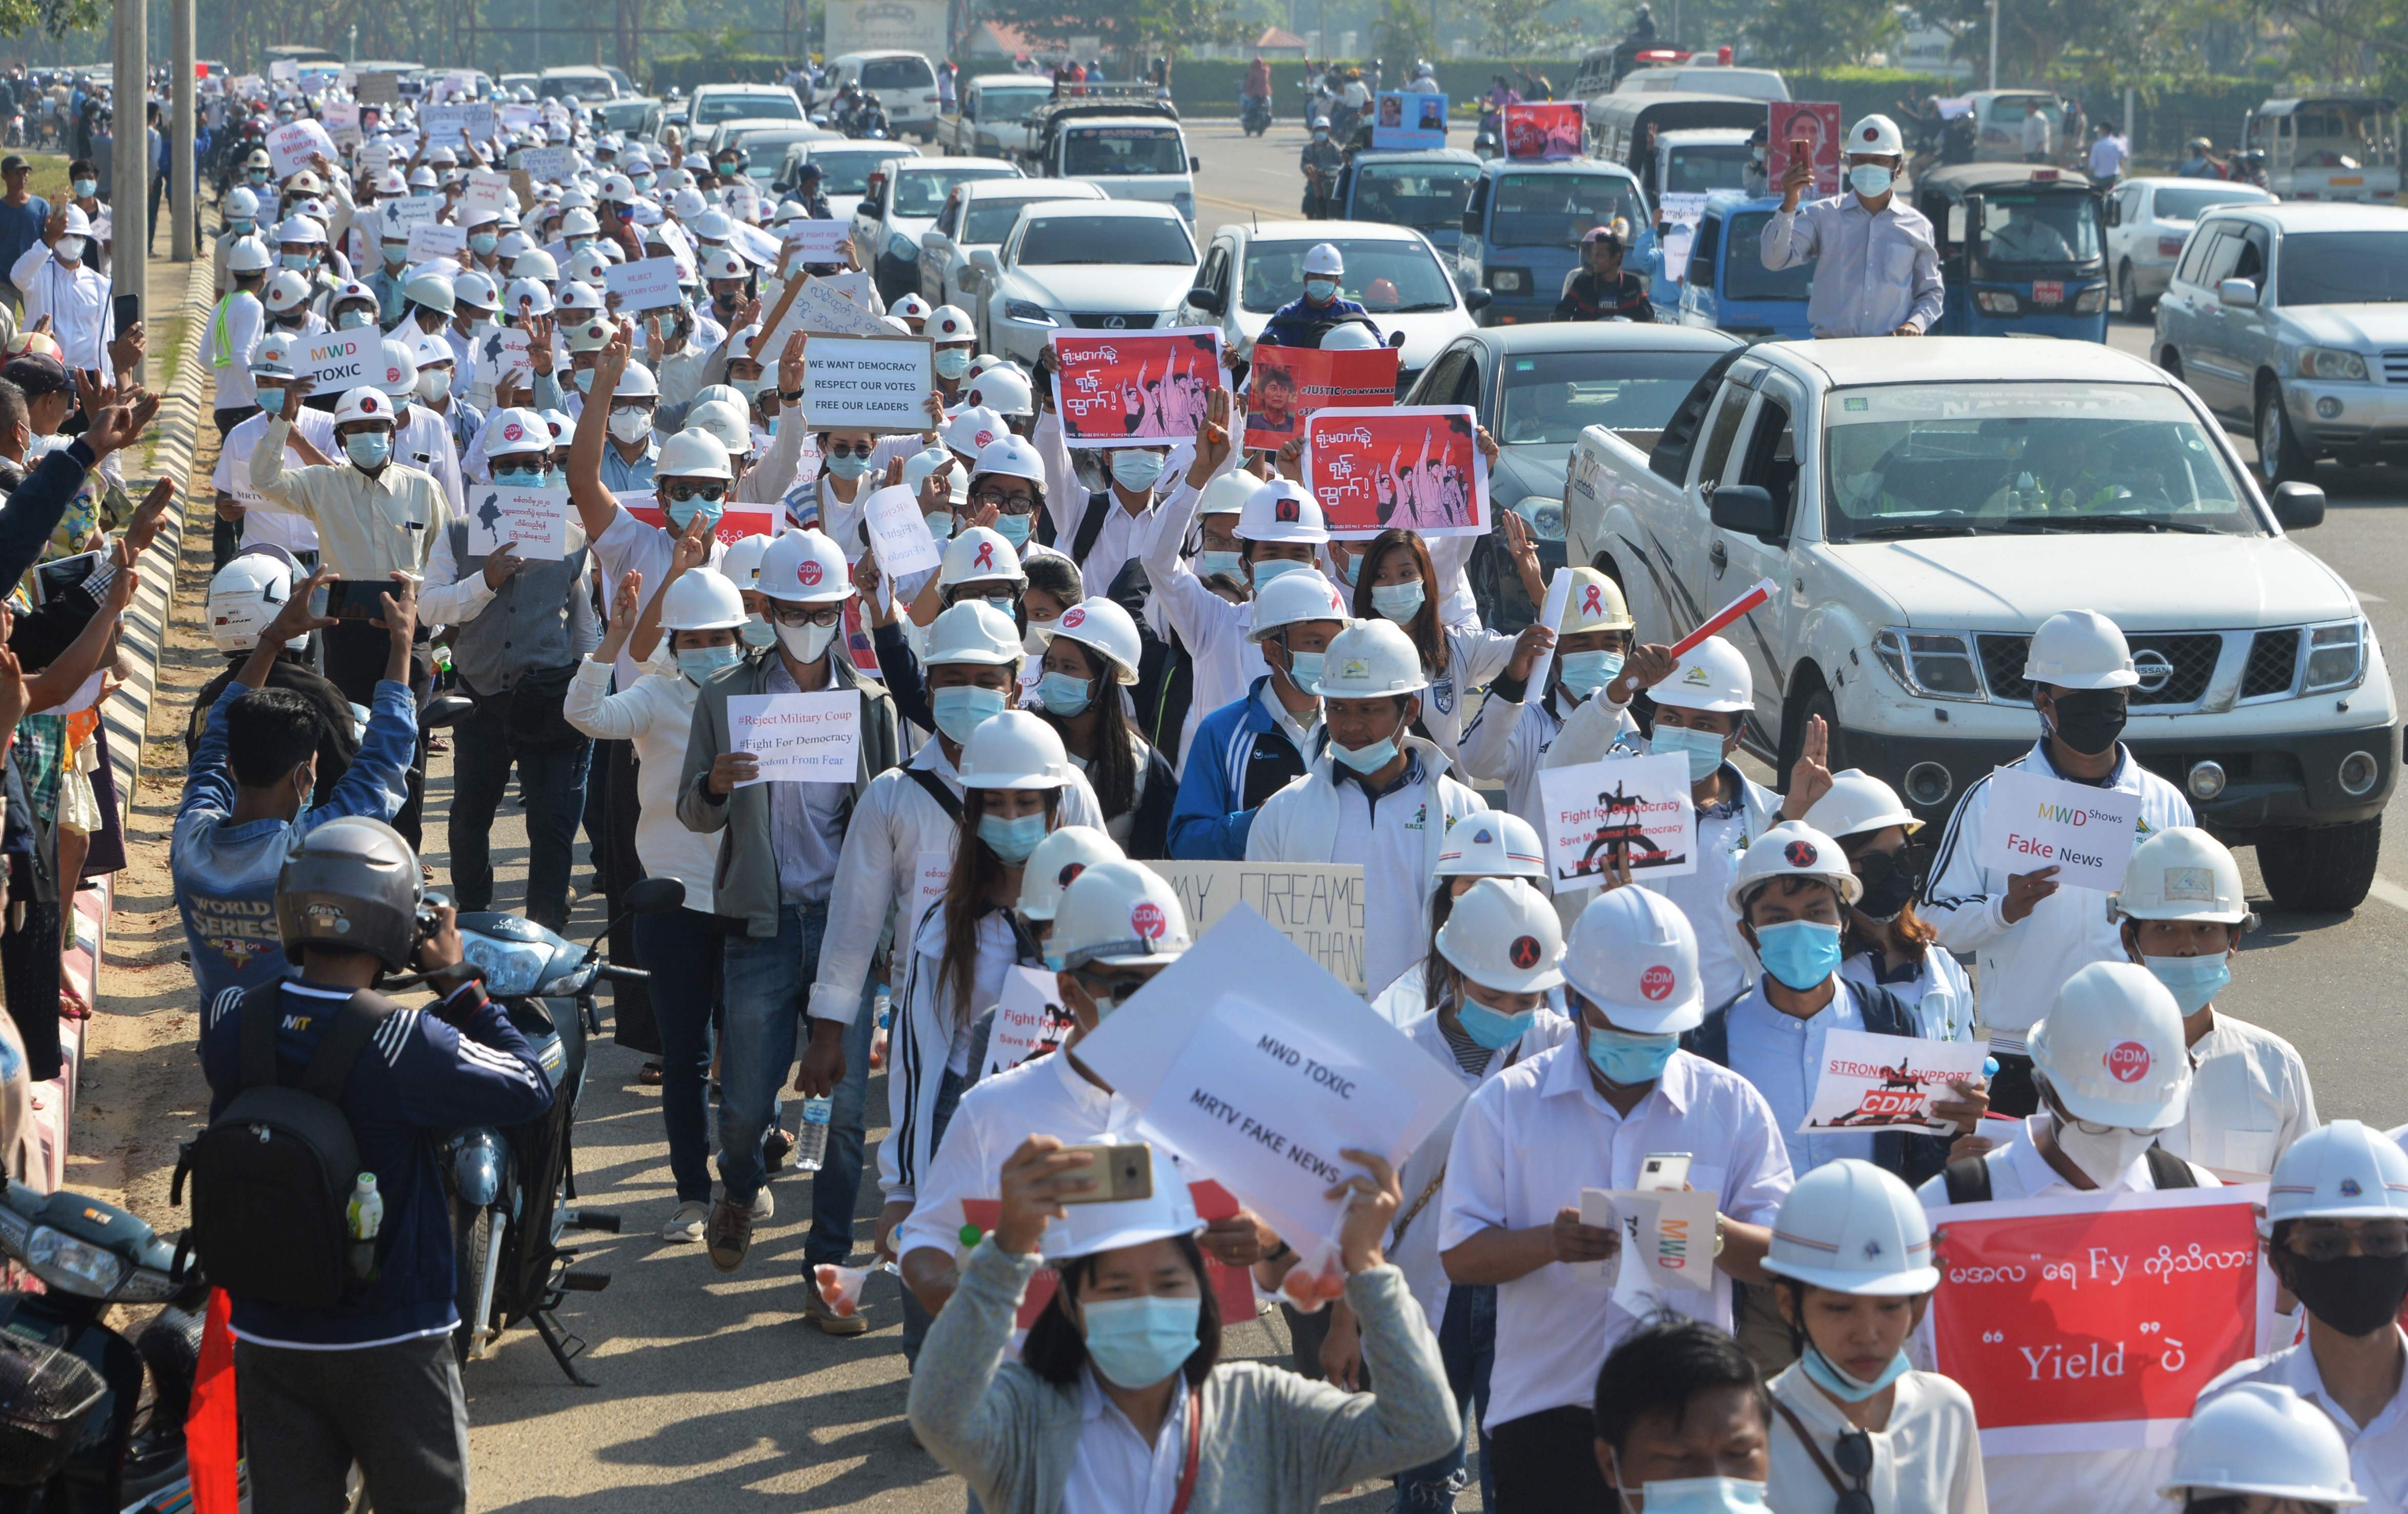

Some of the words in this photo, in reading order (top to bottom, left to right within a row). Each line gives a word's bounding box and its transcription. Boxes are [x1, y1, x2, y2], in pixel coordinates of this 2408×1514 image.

[283, 139, 317, 155] Military
[628, 272, 652, 282] REJECT
[649, 284, 668, 293] COUP
[311, 342, 357, 361] MWD
[313, 363, 362, 383] TOXIC
[809, 360, 824, 368] WE
[858, 362, 916, 371] DEMOCRACY
[815, 380, 858, 389] RESPECT
[860, 382, 882, 390] OUR
[884, 382, 916, 391] VOTES
[1300, 385, 1341, 396] #JUSTIC
[1358, 387, 1395, 395] MYANMAR
[815, 401, 839, 409] FREE
[842, 401, 864, 410] OUR
[866, 402, 909, 411] LEADERS
[977, 432, 993, 441] CDM
[236, 491, 264, 500] MRTV
[798, 564, 820, 573] CDM
[1068, 608, 1085, 620] CDM
[738, 714, 776, 727] #Reject
[780, 713, 822, 725] Military
[825, 711, 852, 724] Coup
[739, 738, 773, 751] #Fight
[776, 738, 794, 748] For
[796, 732, 853, 746] Democracy
[792, 755, 820, 766] From
[822, 755, 844, 766] Fear
[1561, 810, 1591, 824] Fight
[1594, 807, 1609, 816] for
[1613, 801, 1680, 815] Democracy
[2037, 803, 2086, 826] MWD
[2089, 809, 2123, 824] Shows
[1560, 836, 1581, 847] Save
[1583, 829, 1625, 842] Myanmar
[1628, 824, 1683, 836] Democracy
[2007, 833, 2054, 859] Fake
[2059, 847, 2103, 867] News
[190, 895, 271, 915] WORLD
[1240, 872, 1364, 928] DREAMS
[309, 905, 342, 915] Best
[1133, 909, 1164, 922] CDM
[191, 910, 281, 941] SERIES
[492, 924, 521, 933] CANDA
[1305, 931, 1363, 981] THAN
[1643, 971, 1672, 983] CDM
[282, 1014, 312, 1031] NIT
[1004, 1009, 1035, 1026] Fight
[1039, 1016, 1055, 1028] for
[1000, 1033, 1024, 1046] Save
[2112, 1048, 2147, 1063] CDM
[1257, 1034, 1300, 1068] MWD
[1303, 1059, 1357, 1101] TOXIC
[1829, 1060, 1907, 1079] STRONGLY
[1911, 1068, 1972, 1084] SUPPORT
[1860, 1095, 1922, 1113] CDM
[1191, 1088, 1240, 1126] MRTV
[1240, 1117, 1287, 1155] FAKE
[1288, 1146, 1340, 1184] NEWS
[1658, 1219, 1689, 1269] MWD
[2088, 1247, 2130, 1286] Fy
[2018, 1341, 2125, 1381] Yield
